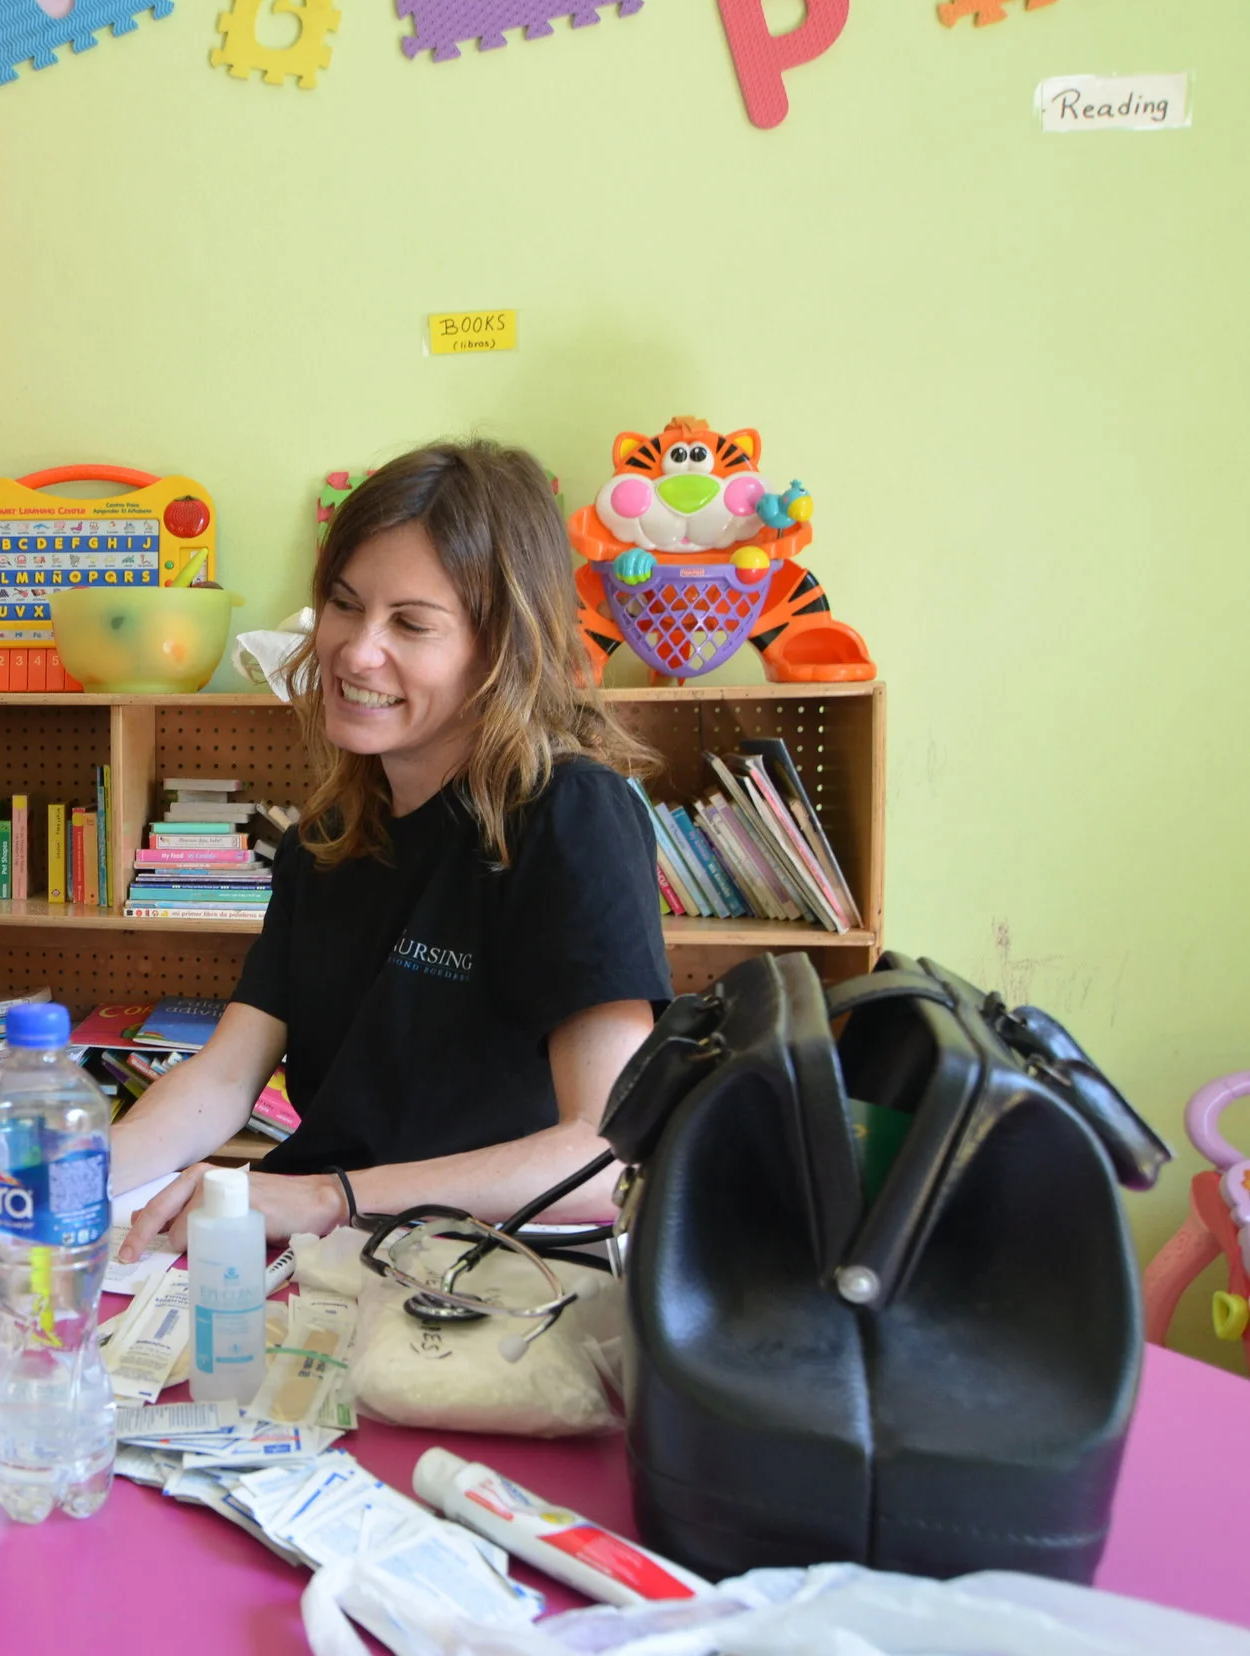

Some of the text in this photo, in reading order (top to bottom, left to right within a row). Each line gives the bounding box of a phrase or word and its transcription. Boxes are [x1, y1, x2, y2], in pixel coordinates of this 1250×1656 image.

[1051, 88, 1168, 122] Reading
[439, 313, 505, 336] BOOKS
[453, 338, 496, 350] (libros)
[1, 538, 12, 550] B
[18, 538, 28, 550] C
[36, 538, 47, 550] D
[54, 538, 64, 549] E
[71, 538, 80, 549] F
[88, 538, 99, 549] G
[107, 537, 118, 549] H
[127, 537, 132, 548] I
[142, 537, 151, 548] J
[0, 572, 9, 584] L
[16, 572, 29, 584] M
[34, 572, 45, 584] N
[52, 570, 63, 584] Ñ
[69, 572, 82, 584] O
[88, 571, 99, 583] P
[104, 571, 118, 583] Q
[124, 571, 133, 583] R
[141, 571, 150, 583] S
[15, 605, 26, 618] V
[34, 605, 44, 618] X
[16, 656, 23, 666] 3
[34, 656, 41, 666] 4
[52, 656, 59, 666] 5
[1, 841, 9, 863] Shapes
